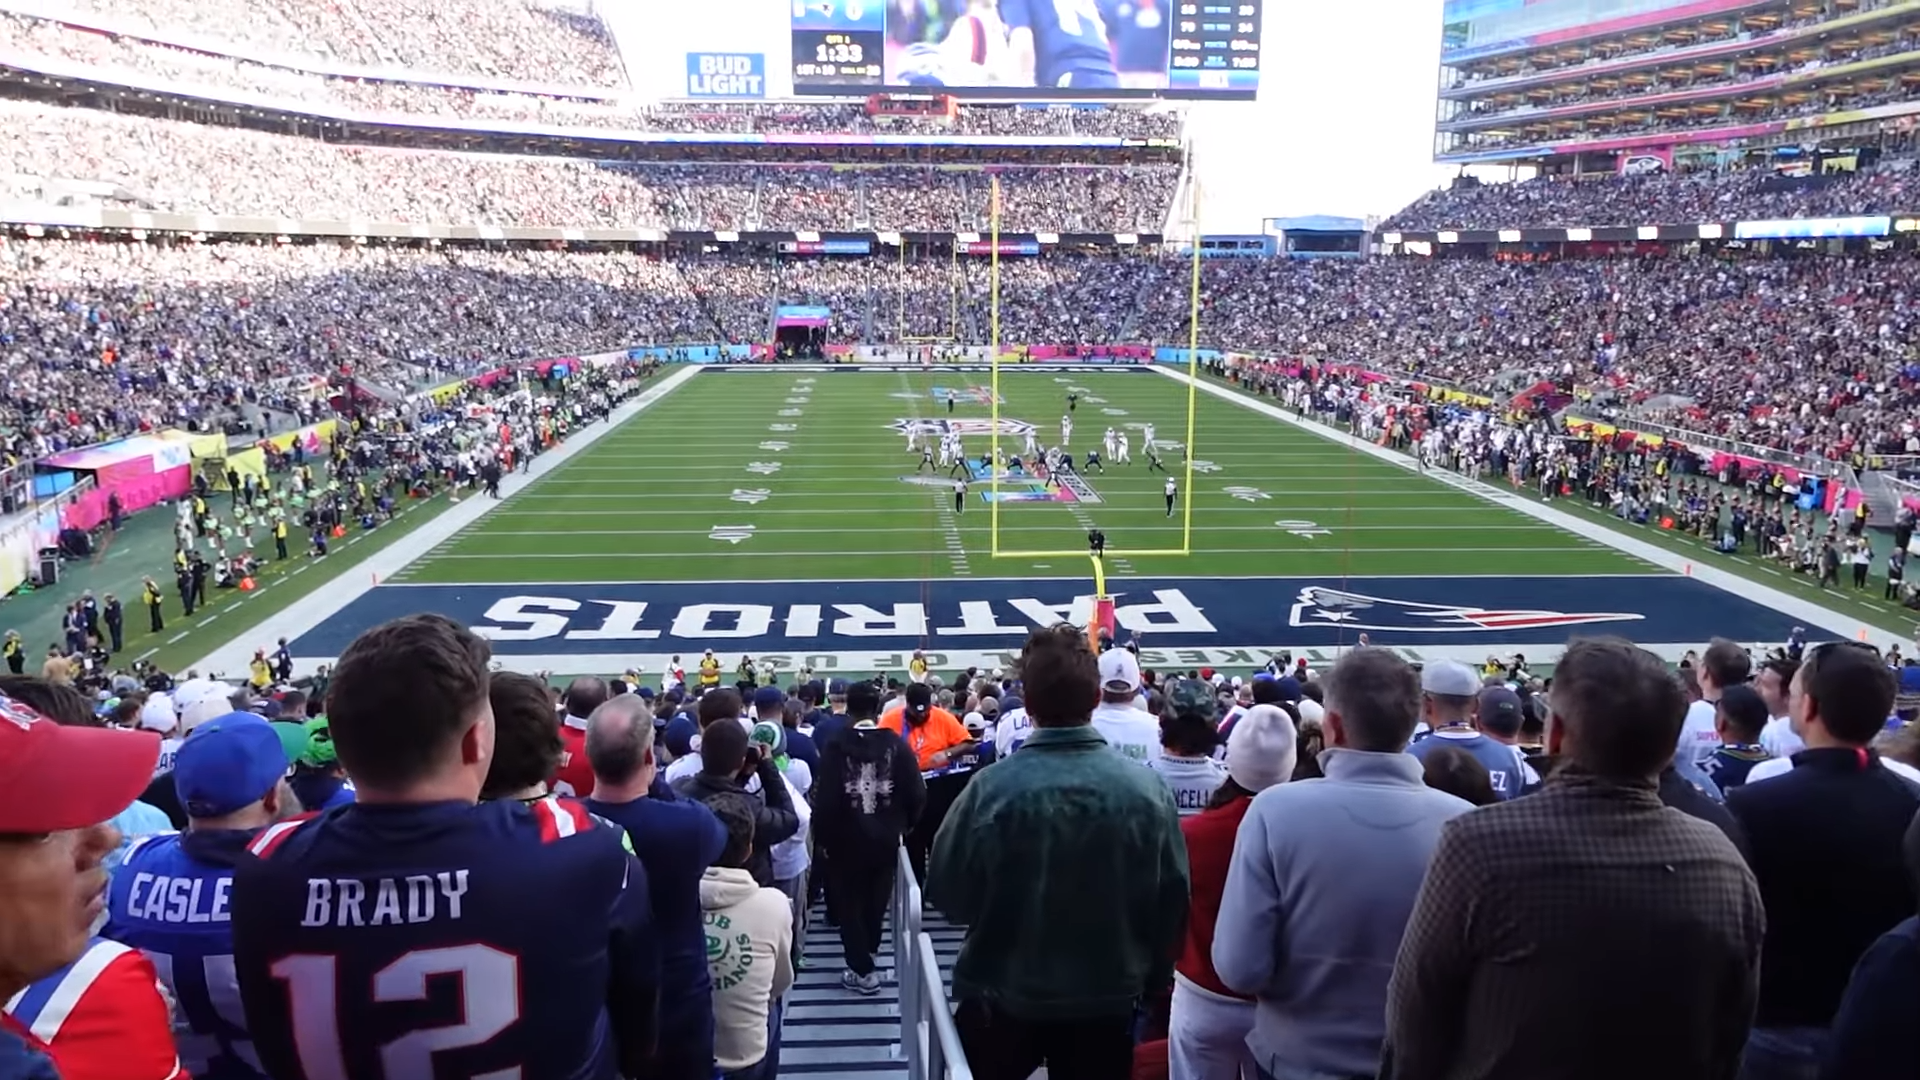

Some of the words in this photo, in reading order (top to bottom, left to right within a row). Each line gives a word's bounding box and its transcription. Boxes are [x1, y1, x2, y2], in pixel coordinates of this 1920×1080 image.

[700, 55, 751, 75] BUD
[816, 44, 863, 62] 1:33
[690, 74, 762, 95] LIGHT
[470, 589, 1217, 640] PATRIOTS
[301, 870, 469, 927] BRADY
[269, 943, 521, 1080] 12
